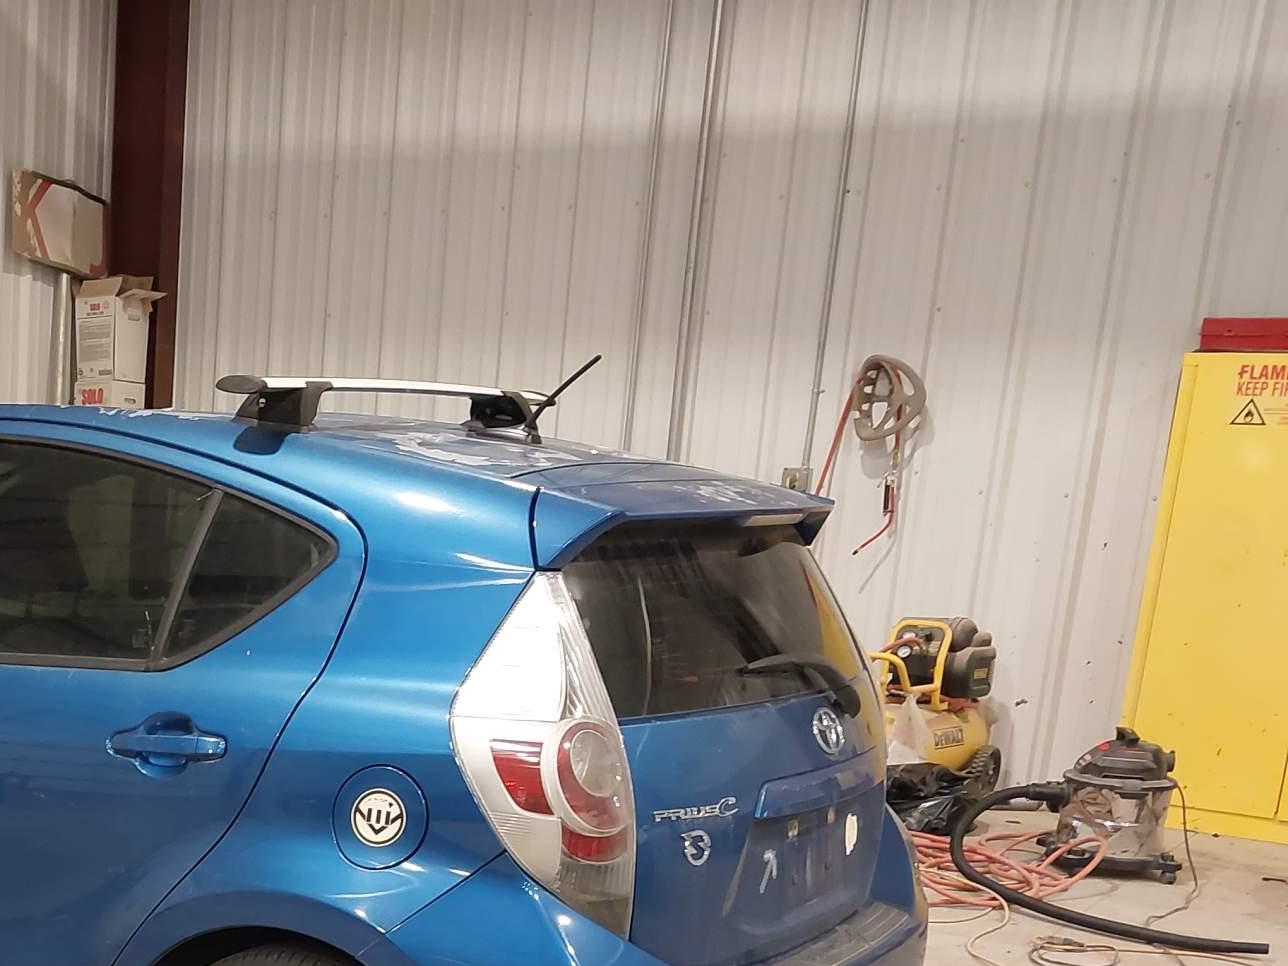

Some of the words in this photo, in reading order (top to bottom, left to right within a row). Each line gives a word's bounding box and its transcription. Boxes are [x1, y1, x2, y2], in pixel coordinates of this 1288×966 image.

[1237, 364, 1288, 380] FLAM
[81, 388, 104, 405] SOLO
[1236, 381, 1268, 397] KEEP
[934, 728, 964, 747] DEWALT
[653, 804, 719, 822] PRIUS
